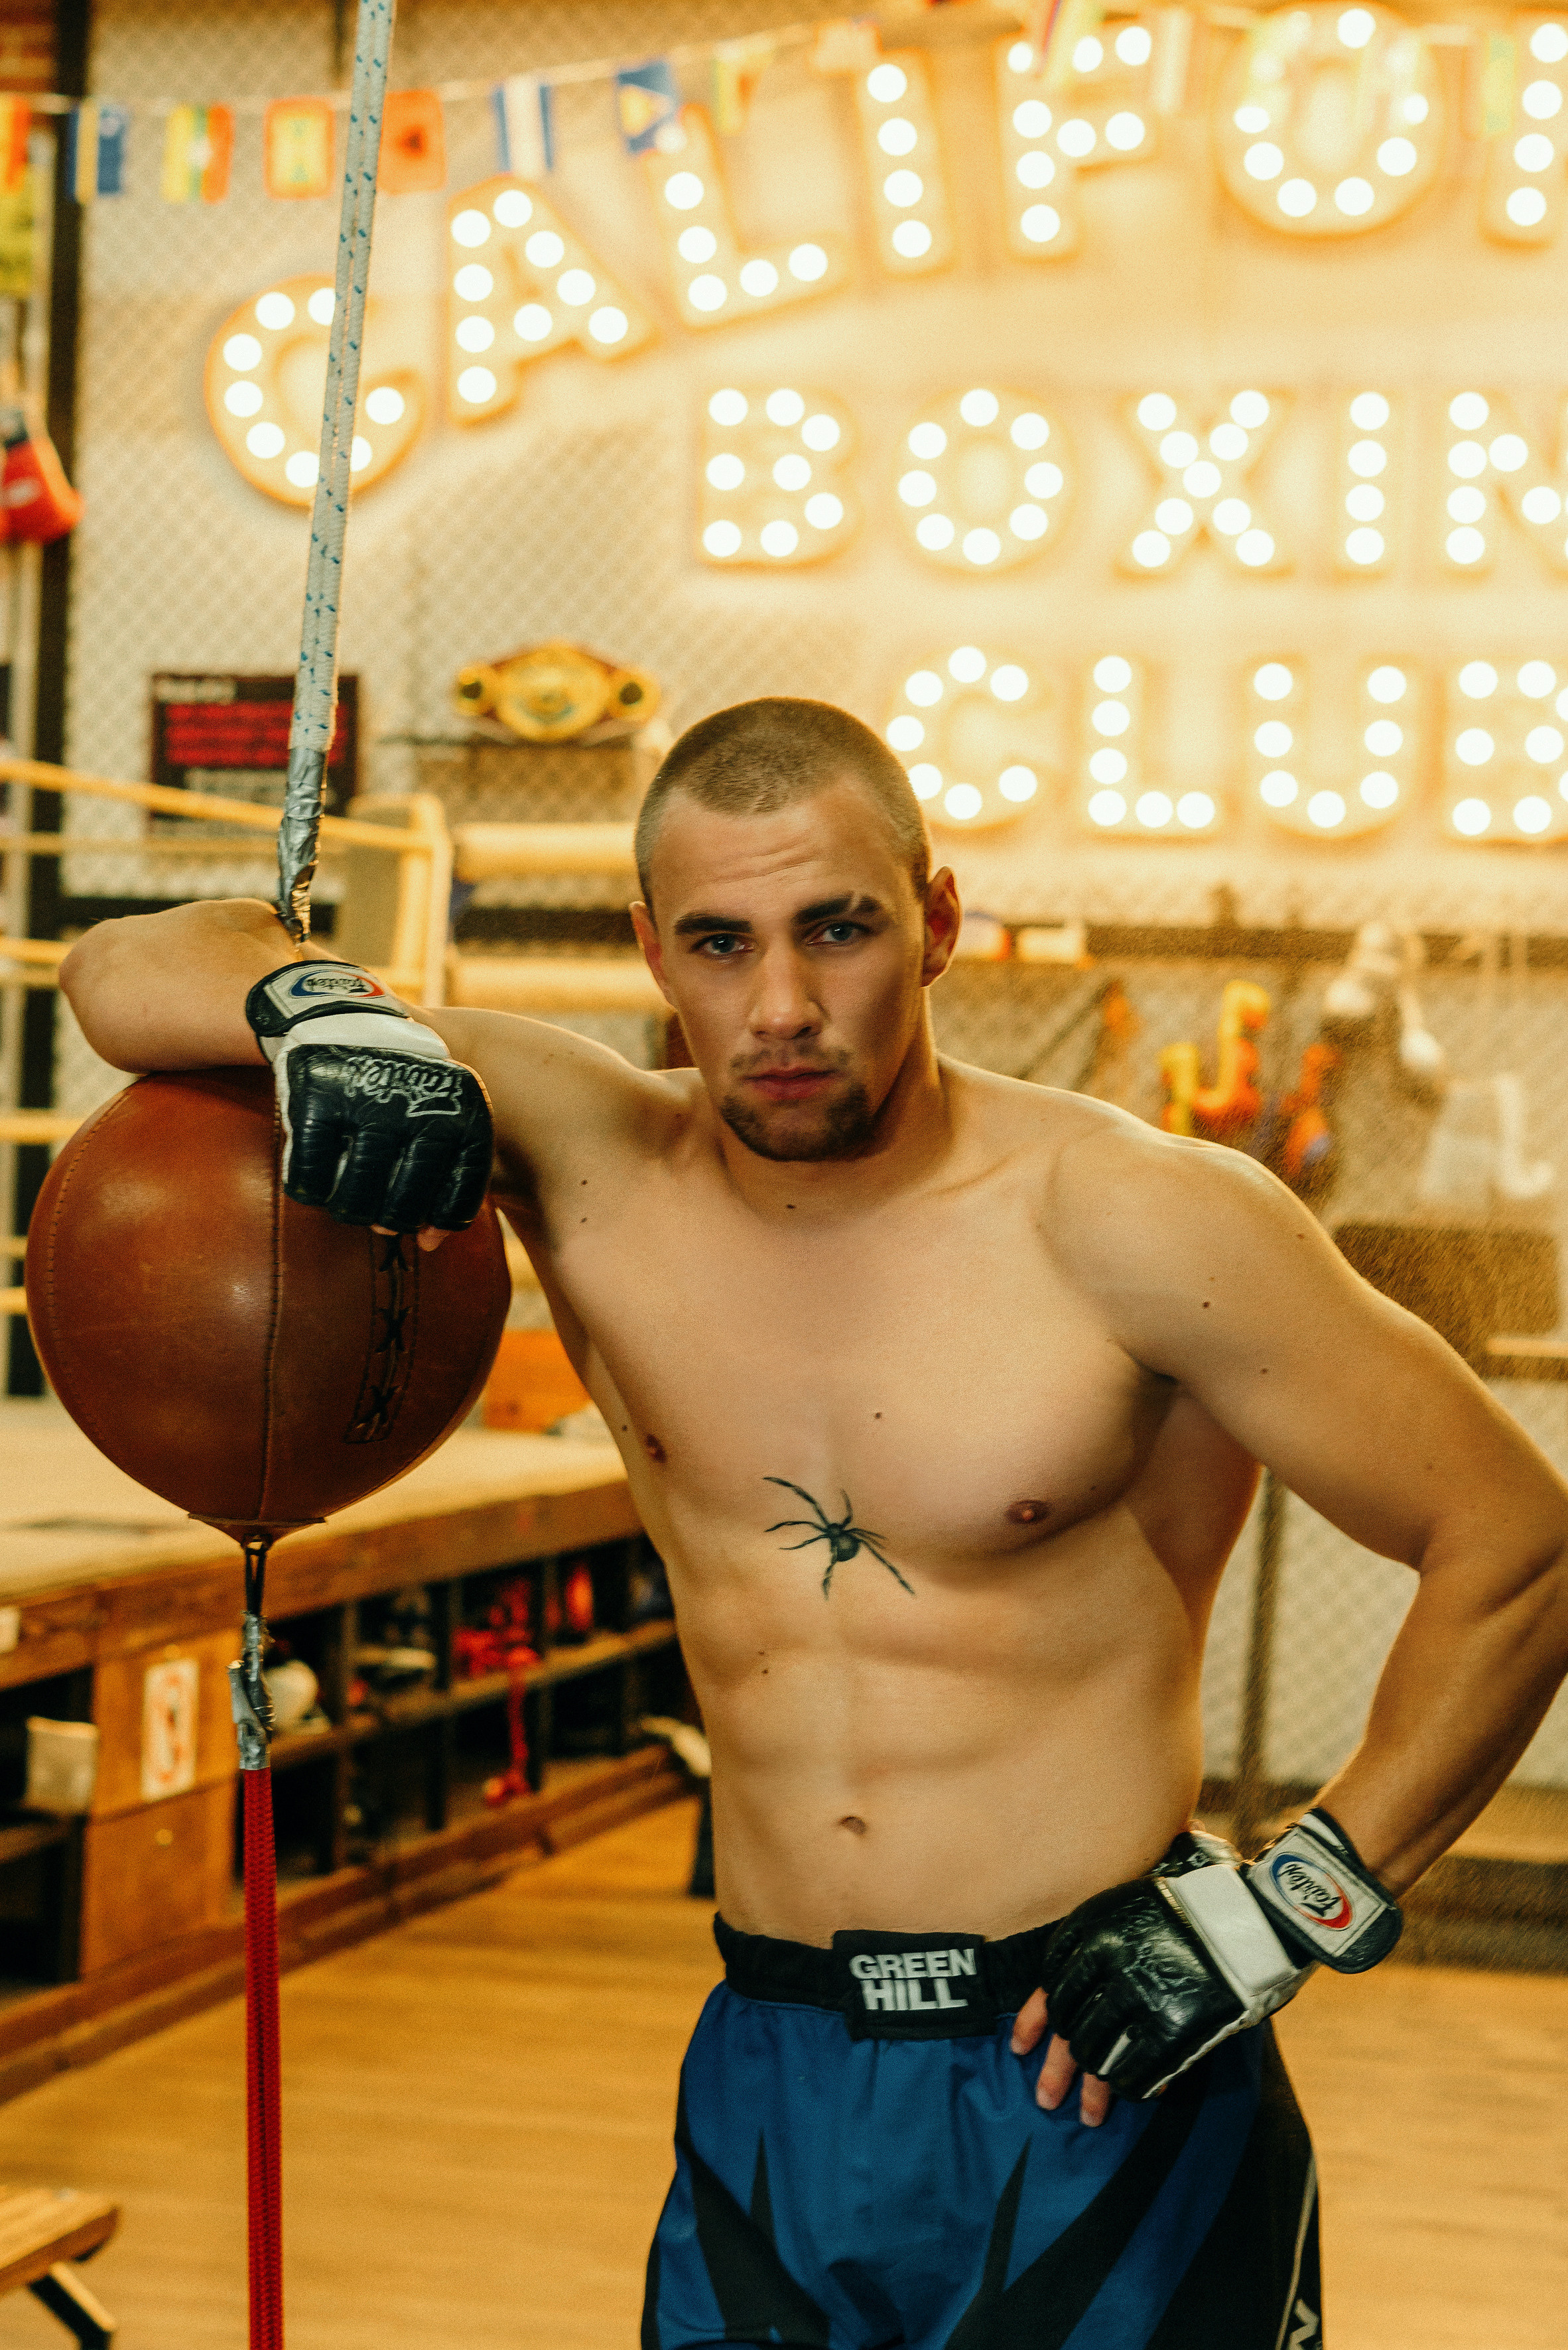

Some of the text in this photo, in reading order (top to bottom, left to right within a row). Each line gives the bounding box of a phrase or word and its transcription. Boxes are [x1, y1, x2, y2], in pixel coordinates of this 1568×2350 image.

[885, 646, 1568, 841] CLUB
[1279, 1863, 1341, 1918] Fairtex
[849, 1949, 977, 1979] GREEN
[861, 1978, 968, 2010] HILL
